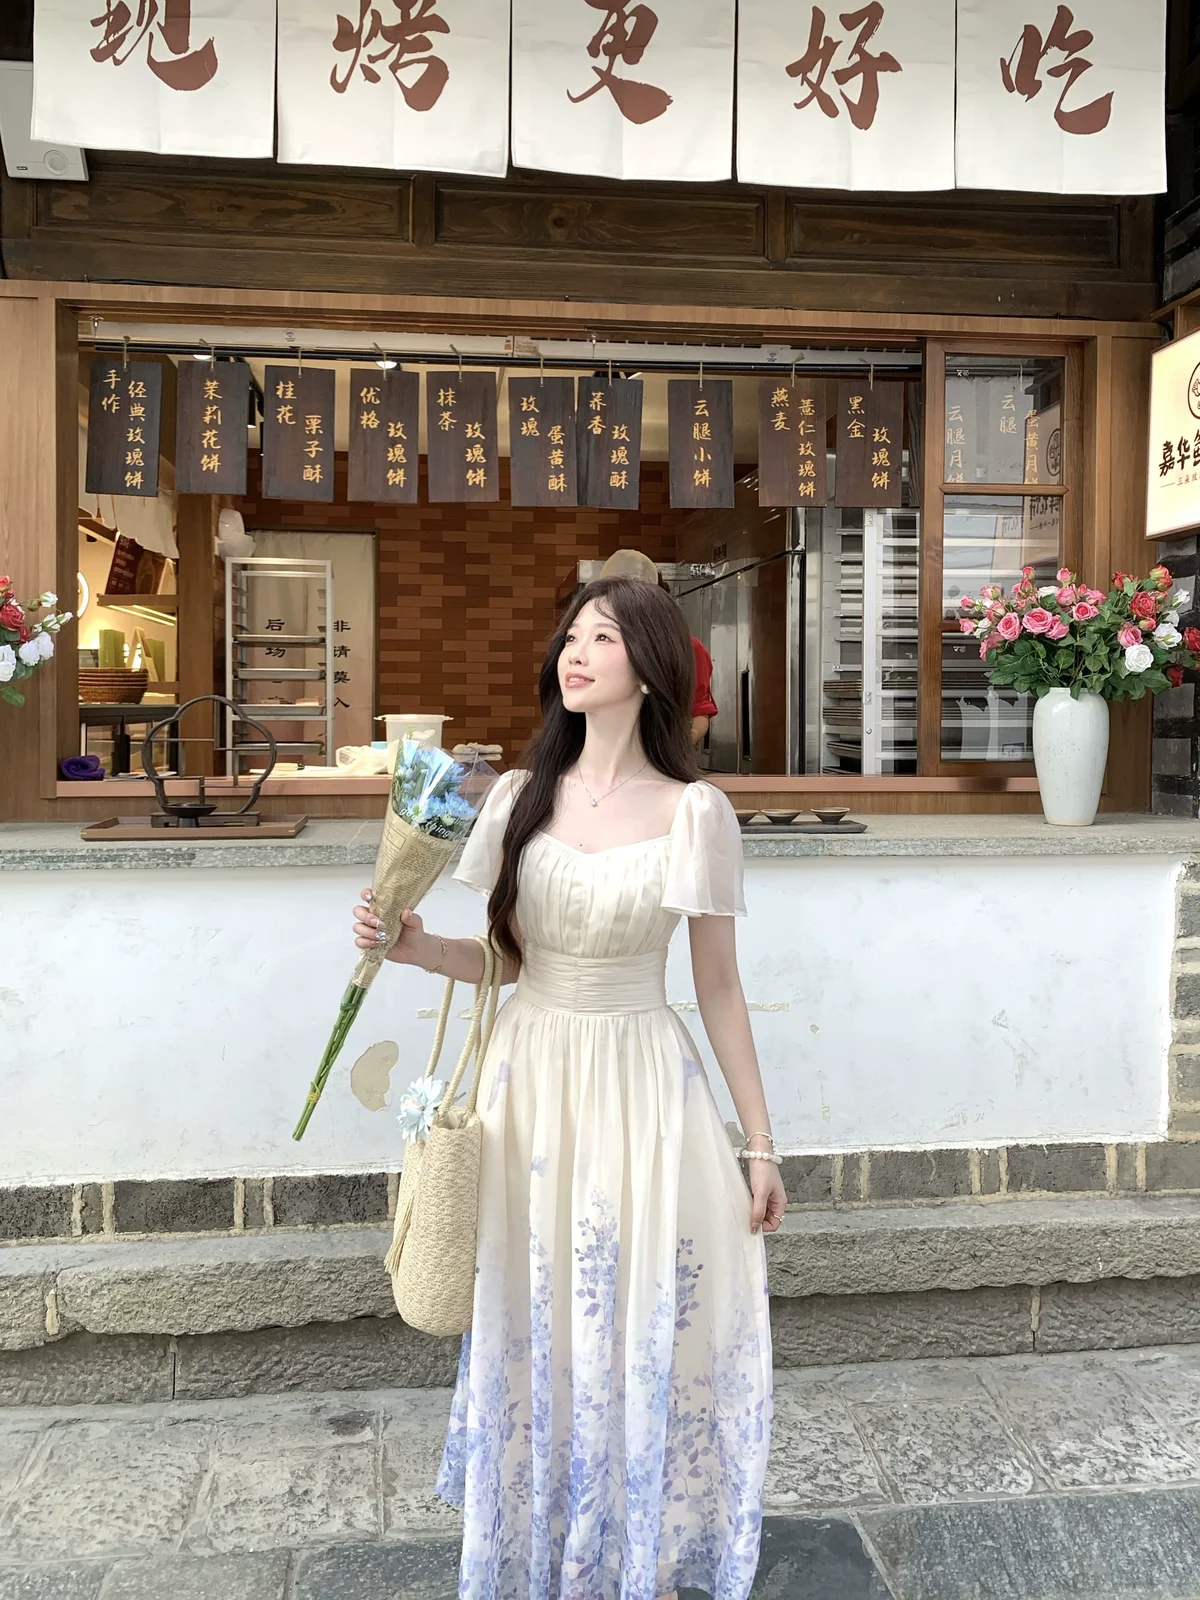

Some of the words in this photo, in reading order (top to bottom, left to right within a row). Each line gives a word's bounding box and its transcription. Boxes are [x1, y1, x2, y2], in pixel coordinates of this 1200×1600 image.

[102, 369, 121, 414] 手作
[276, 380, 297, 425] 桂花
[360, 386, 381, 430] 优格
[436, 387, 458, 431] 抹茶
[520, 394, 540, 438] 玫瑰
[587, 391, 607, 435] 荞香
[770, 387, 791, 431] 燕麦
[846, 395, 866, 438] 黑金
[999, 394, 1017, 434] 云腿
[124, 380, 147, 490] 经典玫瑰饼
[200, 378, 222, 474] 茉莉花饼
[302, 414, 324, 484] 栗子酥
[387, 421, 407, 488] 玫瑰饼
[465, 421, 488, 488] 玫瑰饼
[609, 424, 630, 489] 玫瑰酥
[692, 400, 712, 488] 云腿小饼
[798, 398, 816, 498] 薏仁玫瑰饼
[871, 426, 891, 490] 玫瑰饼
[547, 425, 568, 493] 蛋黄酥
[333, 620, 351, 708] 非请莫入
